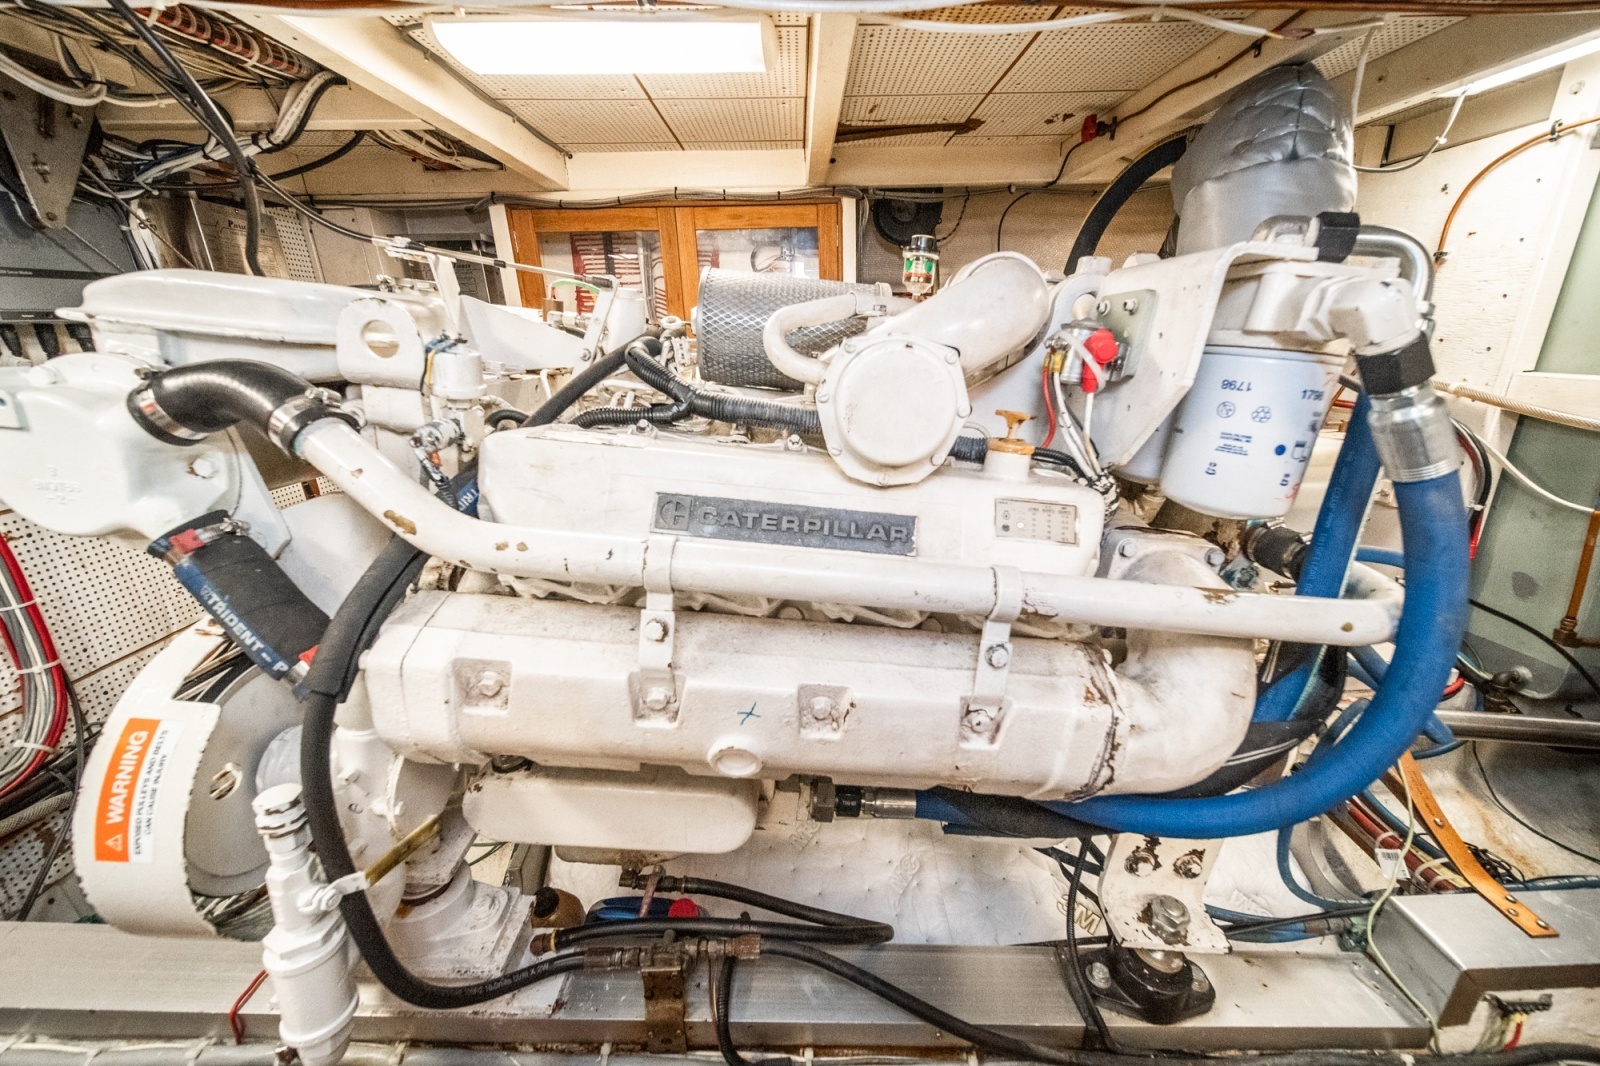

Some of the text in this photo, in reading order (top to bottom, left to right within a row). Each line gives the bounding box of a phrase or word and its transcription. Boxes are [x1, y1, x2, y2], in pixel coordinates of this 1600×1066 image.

[1221, 379, 1252, 392] 1798
[698, 506, 910, 543] CATERPILLAR
[207, 595, 265, 652] TRIDENT
[106, 730, 149, 825] WARNING
[134, 729, 169, 855] EXPOSED PULLEYS AND BELTS
[143, 755, 167, 836] CAN CAUSE INJURY
[1057, 894, 1102, 936] 3M
